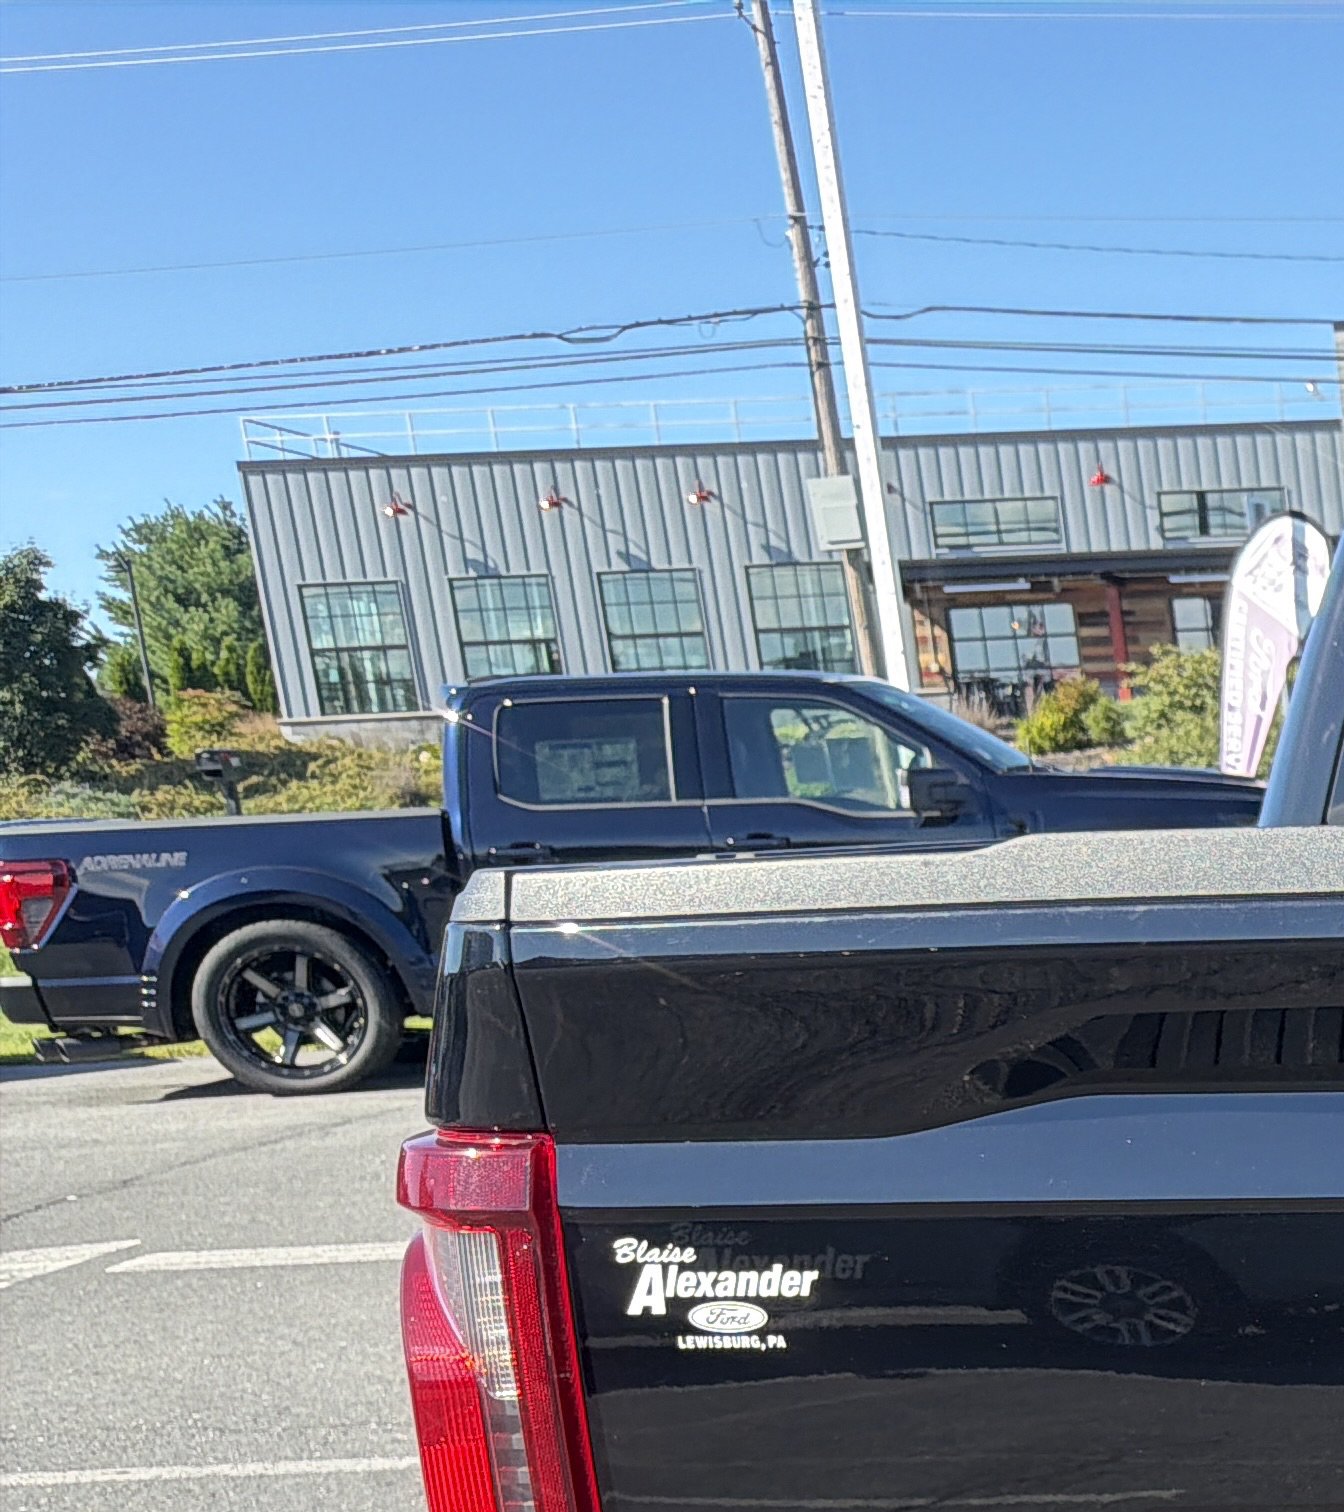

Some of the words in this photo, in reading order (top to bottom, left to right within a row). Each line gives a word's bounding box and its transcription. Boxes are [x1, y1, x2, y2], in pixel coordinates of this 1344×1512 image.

[79, 851, 188, 873] ADRENALINE
[612, 1237, 697, 1264] Blaise
[626, 1263, 819, 1316] Alexander
[705, 1307, 751, 1326] Ford
[767, 1335, 787, 1349] PA
